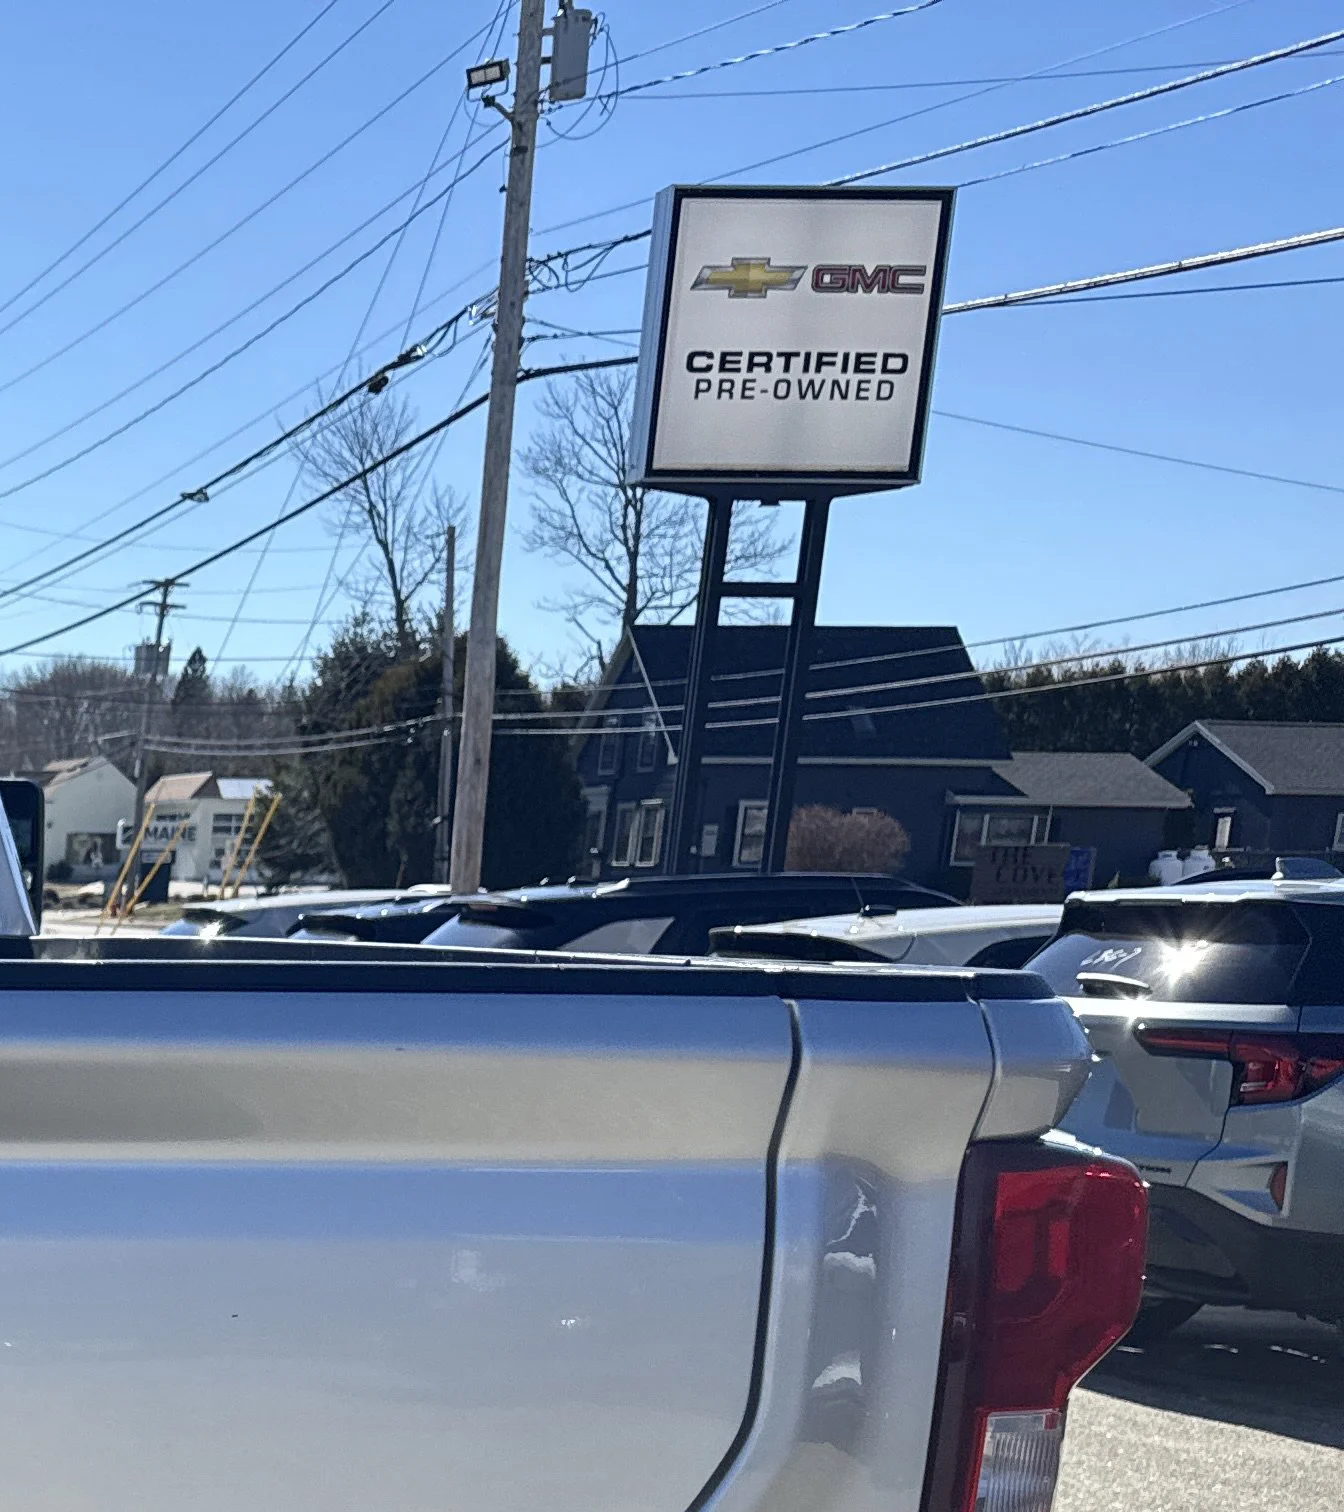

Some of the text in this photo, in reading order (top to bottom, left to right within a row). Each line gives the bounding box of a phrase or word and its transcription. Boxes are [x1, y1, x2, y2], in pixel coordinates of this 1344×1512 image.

[811, 264, 927, 295] GMC
[686, 351, 909, 375] CERTIFIED
[693, 378, 895, 402] PRE-OWNED
[996, 866, 1058, 884] COVE
